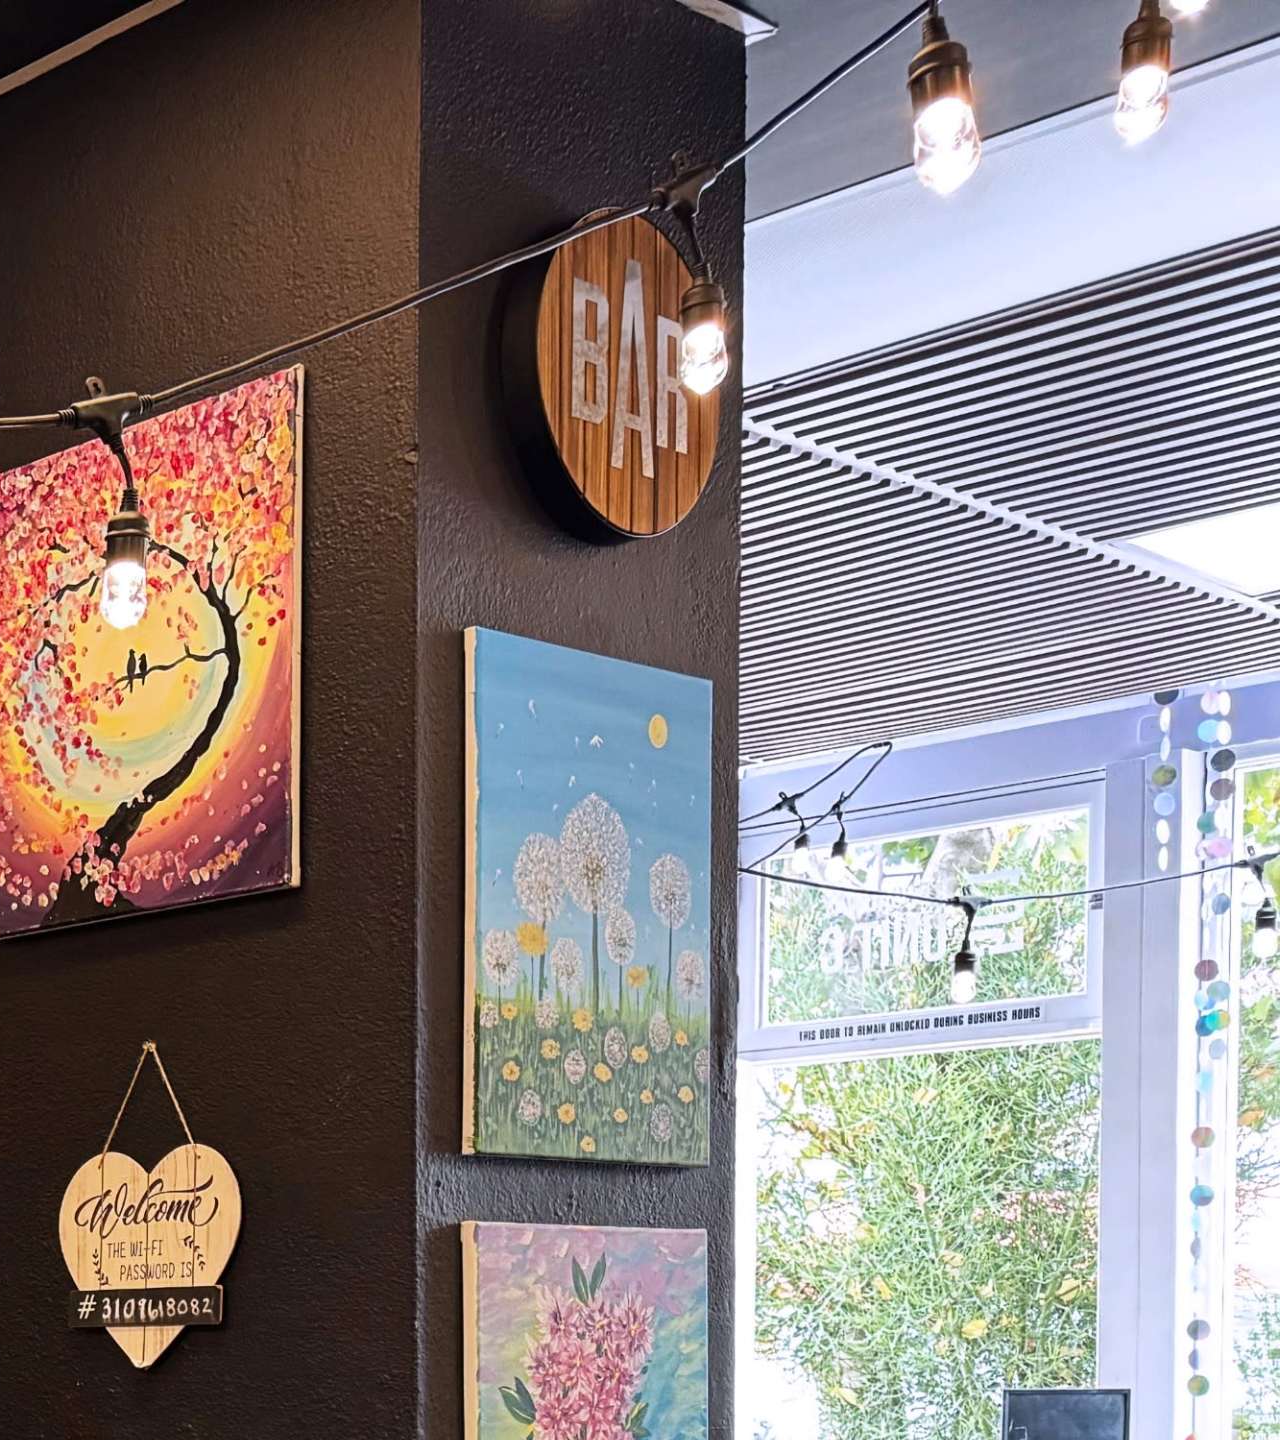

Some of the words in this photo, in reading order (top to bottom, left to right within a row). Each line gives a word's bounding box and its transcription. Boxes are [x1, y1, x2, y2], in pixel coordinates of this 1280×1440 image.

[572, 259, 688, 479] BAR
[799, 1031, 815, 1041] THIS
[820, 1028, 840, 1039] DOOR
[844, 1027, 853, 1037] TO
[858, 1023, 886, 1036] REMAIN
[890, 1018, 930, 1032] UNLOCKED
[934, 1015, 963, 1028] DURING
[968, 1010, 1008, 1025] BUSINESS
[1012, 1006, 1040, 1020] HOURS
[75, 1175, 218, 1238] Welcome
[107, 1241, 127, 1259] THE
[130, 1239, 163, 1258] WI-FI
[120, 1263, 175, 1281] PASSWORD
[180, 1261, 192, 1278] IS
